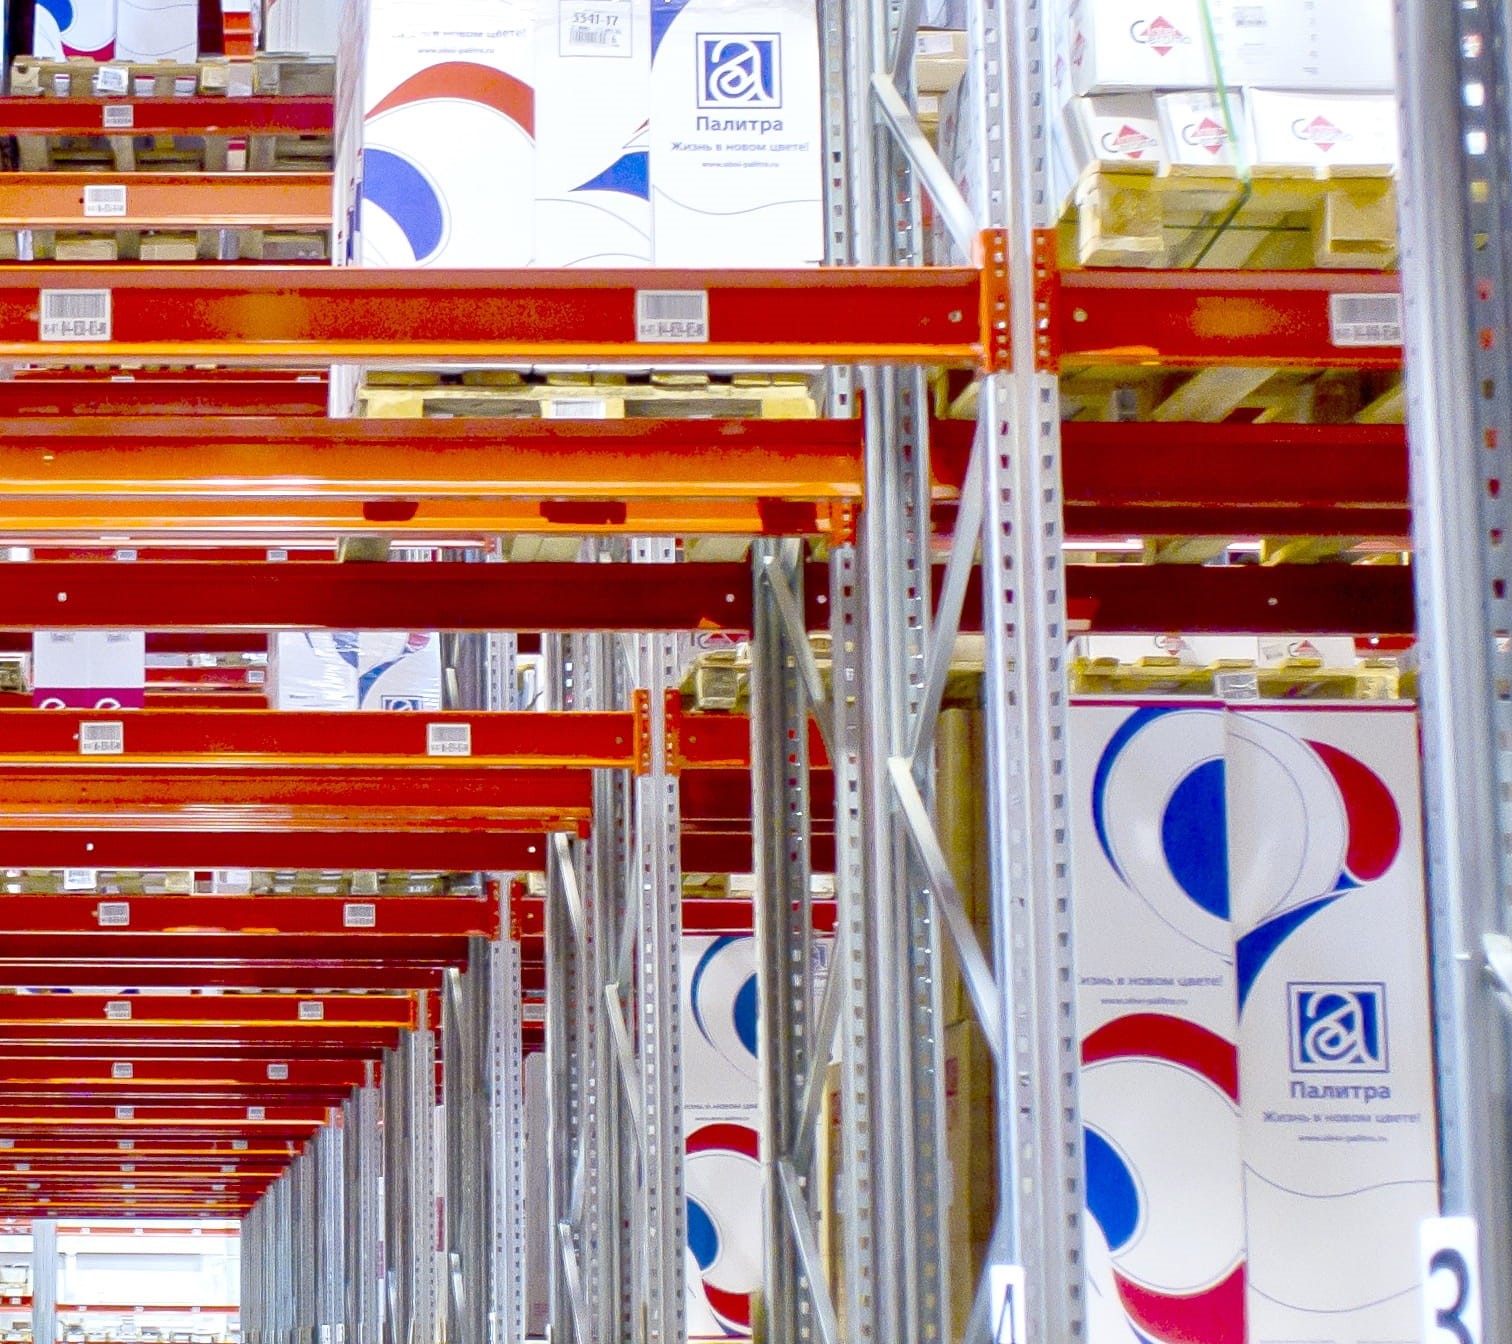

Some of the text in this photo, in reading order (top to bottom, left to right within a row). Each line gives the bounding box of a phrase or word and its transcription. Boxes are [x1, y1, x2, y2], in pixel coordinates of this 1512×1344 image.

[696, 115, 783, 135] Палитра
[726, 143, 767, 152] новом
[1289, 1080, 1392, 1105] Палитра
